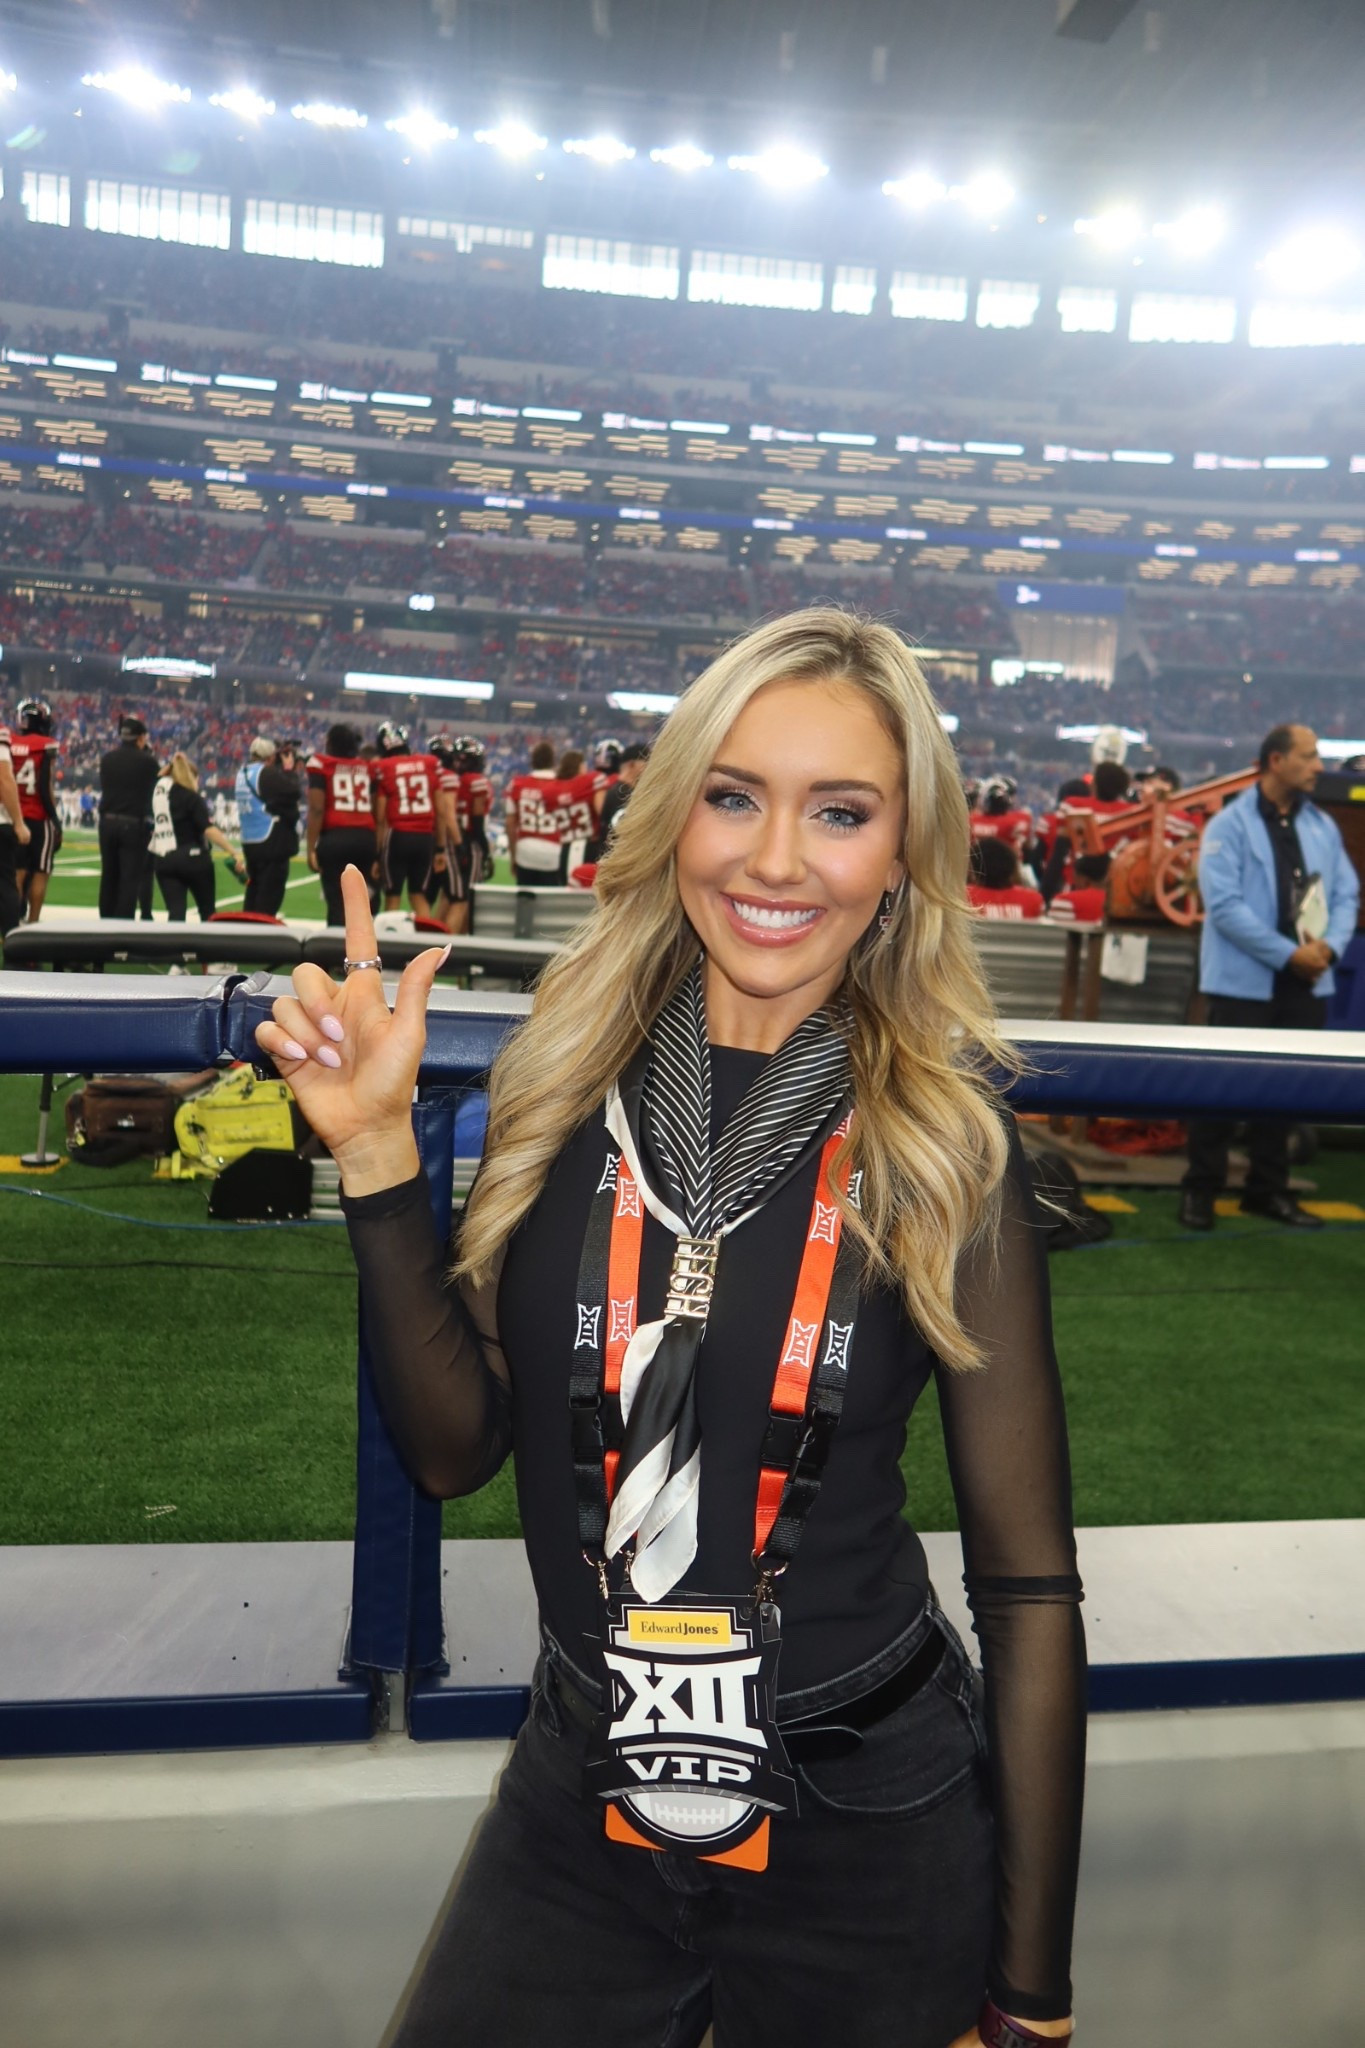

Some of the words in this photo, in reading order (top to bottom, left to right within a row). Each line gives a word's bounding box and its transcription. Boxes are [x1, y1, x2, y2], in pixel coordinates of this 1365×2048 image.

[333, 773, 372, 813] 93
[396, 775, 432, 814] 13
[663, 1232, 724, 1319] TECH
[603, 1651, 769, 1749] XII
[625, 1756, 752, 1783] VIP
